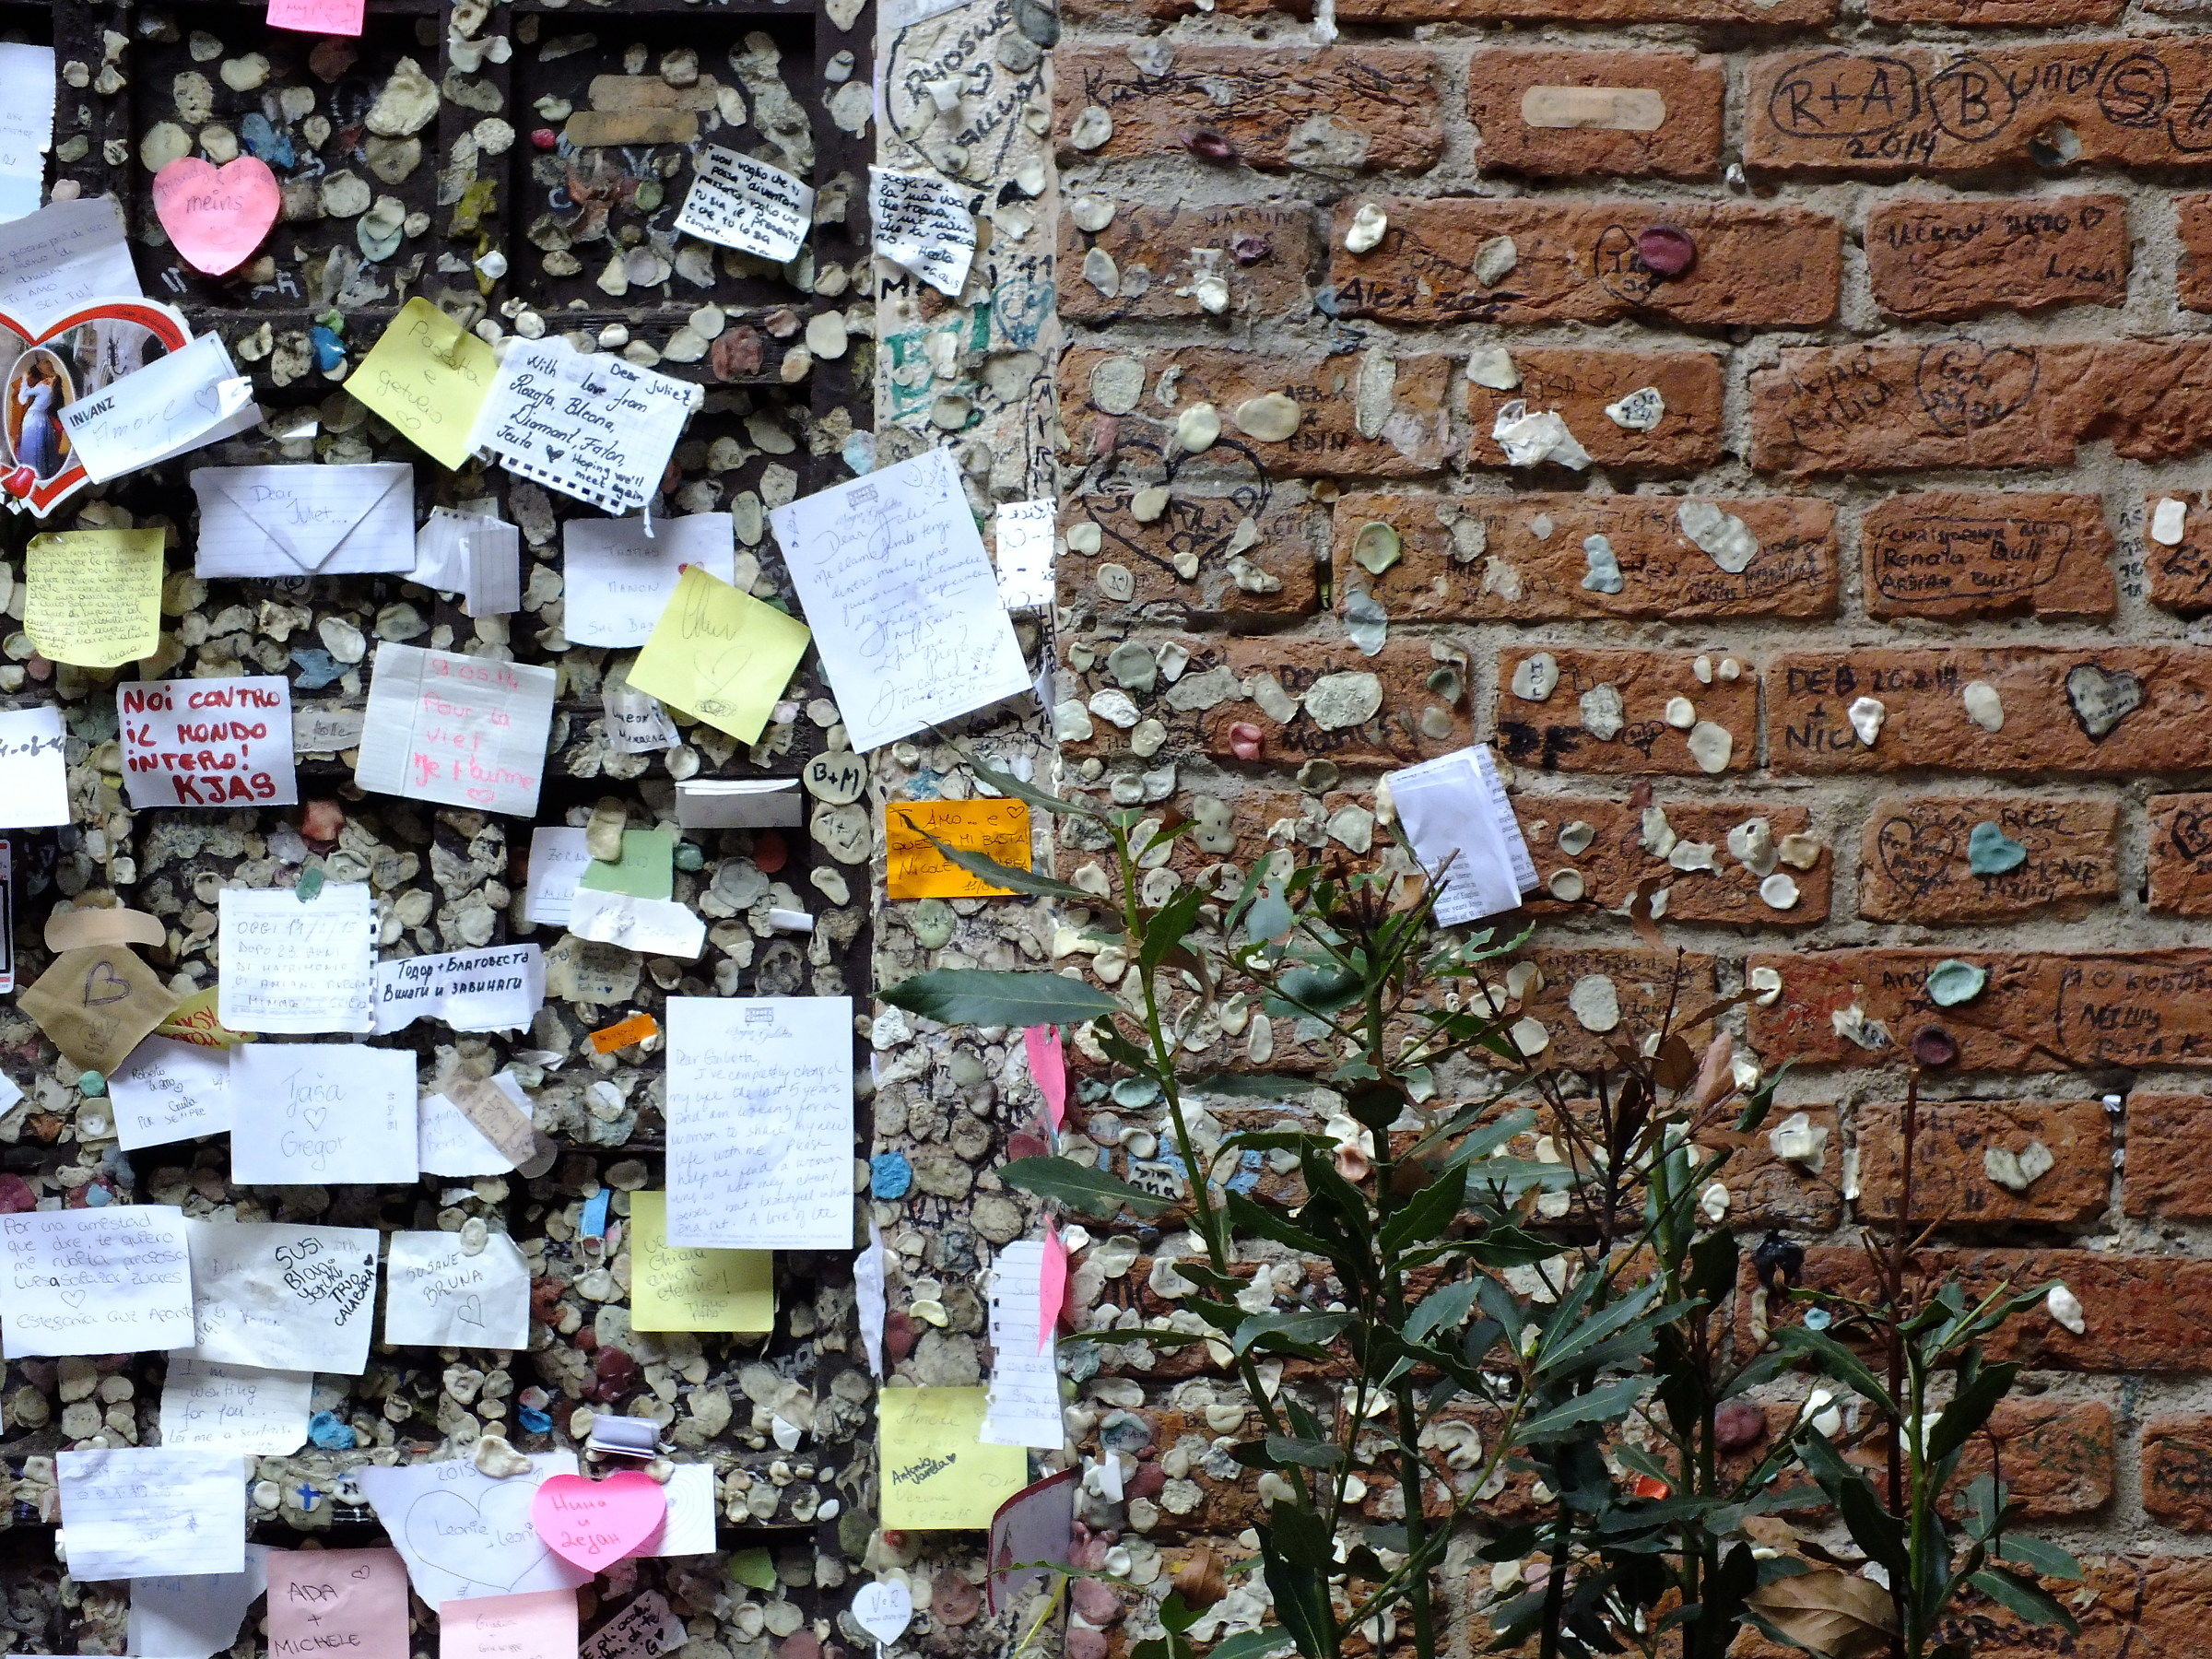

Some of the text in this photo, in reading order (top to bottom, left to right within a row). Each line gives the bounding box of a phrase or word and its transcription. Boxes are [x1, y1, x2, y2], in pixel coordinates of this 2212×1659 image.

[1786, 67, 1895, 128] R+A
[1846, 131, 1939, 163] 2014
[186, 190, 243, 213] meins
[527, 355, 648, 413] With love from
[609, 363, 691, 406] Dear Juliet
[69, 395, 116, 428] INVANZ
[571, 453, 644, 488] Hoping we'll
[575, 468, 644, 502] meet again
[250, 485, 294, 501] Dear
[124, 684, 281, 714] NOi CONTRO
[423, 692, 472, 718] Pour
[126, 720, 267, 747] iL MONDO
[127, 744, 250, 773] iNTERO!
[172, 771, 276, 805] KJAS
[813, 763, 859, 795] B+M
[987, 814, 997, 826] e
[959, 833, 974, 845] MI
[983, 828, 1030, 846] BASTA!
[239, 941, 271, 955] DOPO
[398, 960, 434, 980] Тодор
[448, 951, 530, 971] Благовеста
[383, 977, 523, 1003] Винаги и завинаги
[280, 1129, 347, 1171] Gregor
[5, 1217, 29, 1235] Por
[7, 1240, 36, 1258] que
[96, 1232, 112, 1245] te
[276, 1237, 324, 1270] SUSI
[423, 1268, 484, 1308] BRUNA
[182, 1401, 205, 1429] for
[436, 1464, 477, 1482] 2015
[891, 1456, 933, 1486] Antonio
[435, 1520, 536, 1547] Leonie Leoni
[289, 1581, 340, 1603] ADA
[275, 1633, 361, 1656] MICHELE
